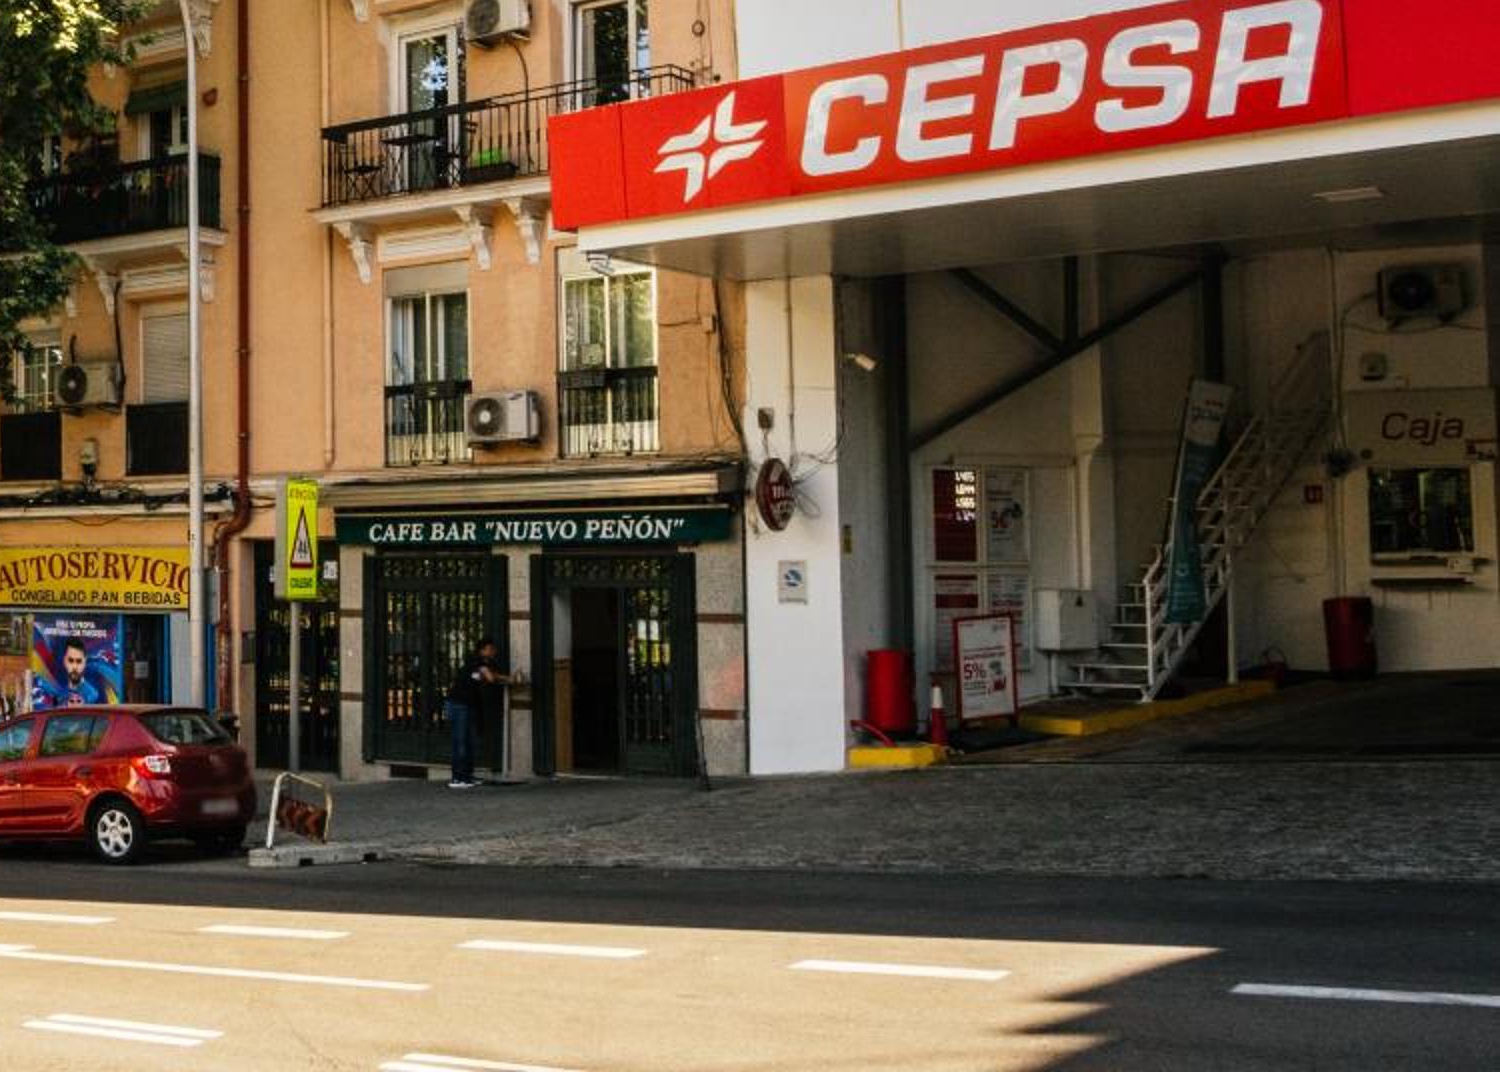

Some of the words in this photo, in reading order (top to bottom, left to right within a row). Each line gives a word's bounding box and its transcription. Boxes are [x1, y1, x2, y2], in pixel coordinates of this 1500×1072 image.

[1381, 411, 1464, 447] Caja
[368, 523, 425, 542] CAFE
[429, 522, 477, 541] BAR
[484, 519, 577, 541] "NUEVO
[583, 514, 685, 540] PEÑÓN"
[11, 589, 87, 604] CONGELADO
[91, 591, 119, 604] PAN
[124, 591, 181, 606] BEBIDAS
[963, 663, 987, 680] 5%
